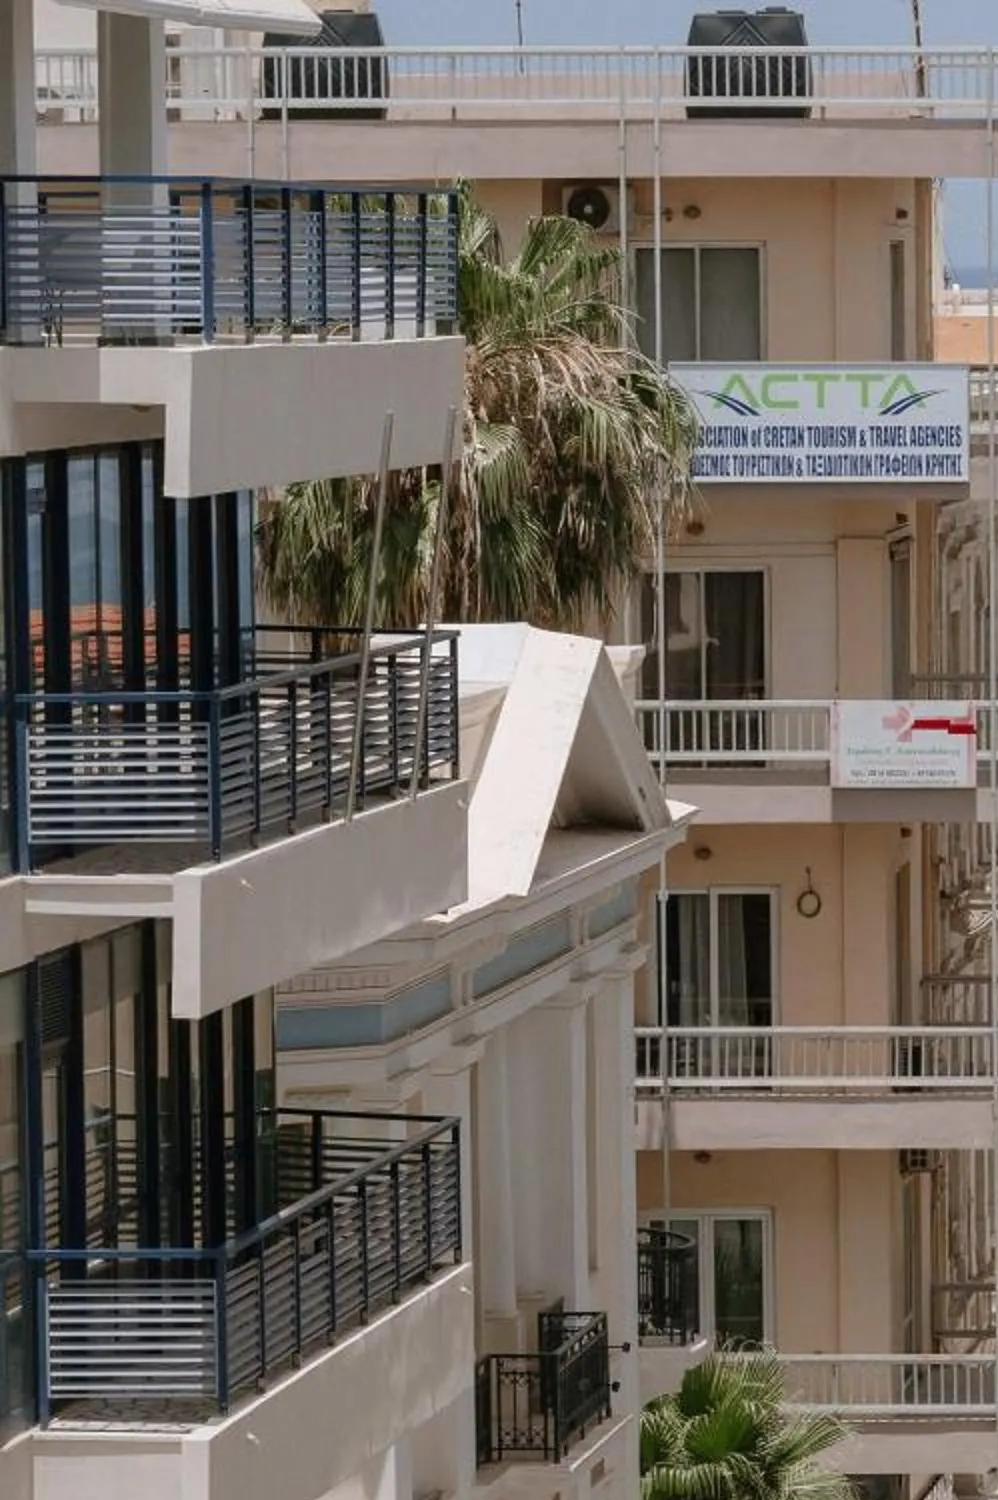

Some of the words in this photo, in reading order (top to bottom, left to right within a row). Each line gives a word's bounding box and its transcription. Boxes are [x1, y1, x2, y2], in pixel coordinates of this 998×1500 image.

[711, 372, 928, 410] ACTTA
[751, 425, 761, 448] of
[763, 425, 805, 448] CRETAN
[807, 425, 857, 448] TOURISM
[859, 429, 867, 447] &
[869, 425, 908, 448] TRAVEL
[910, 424, 962, 448] AGENCIES
[796, 457, 803, 477] &
